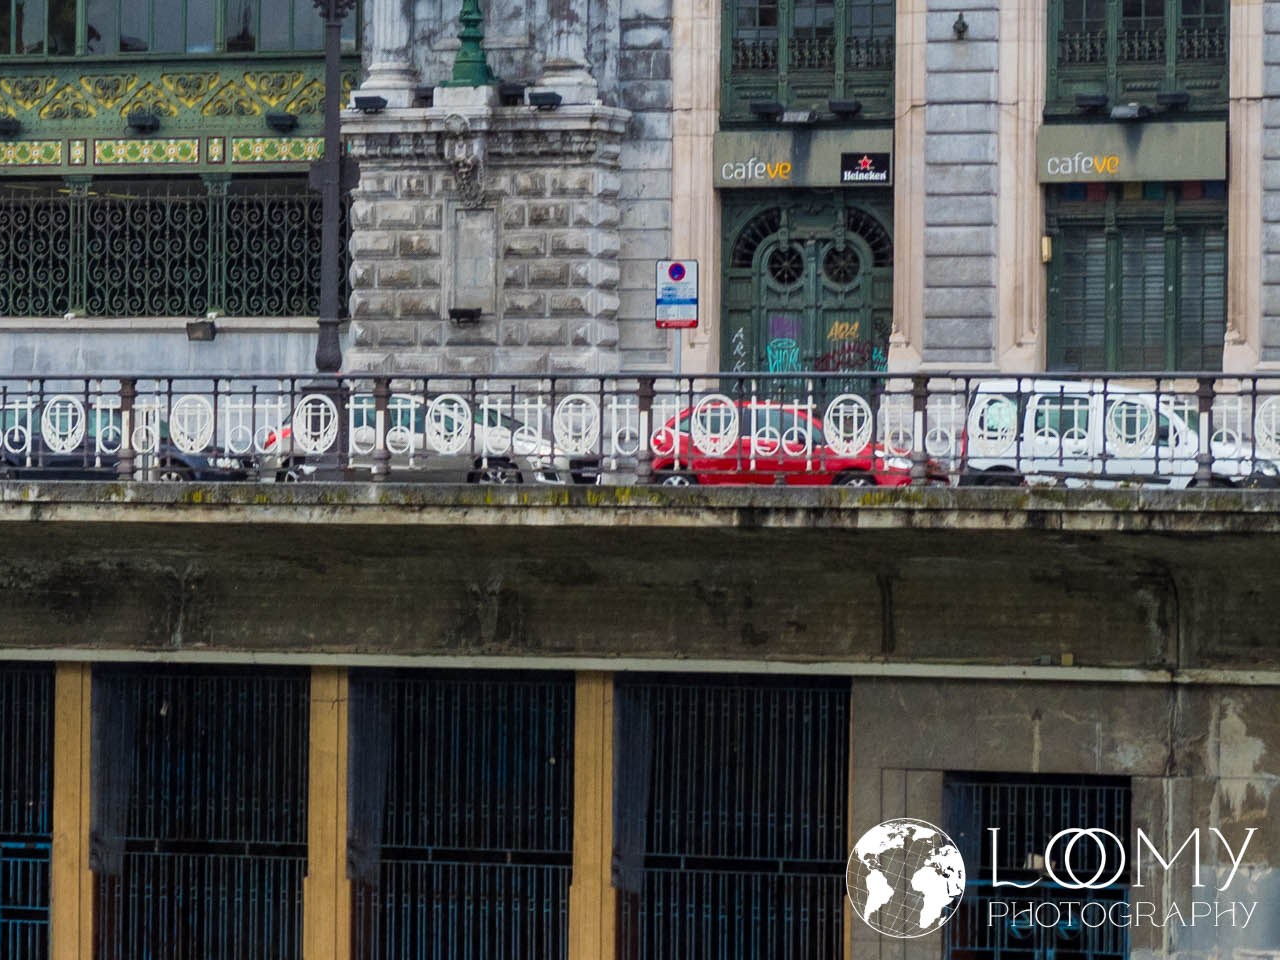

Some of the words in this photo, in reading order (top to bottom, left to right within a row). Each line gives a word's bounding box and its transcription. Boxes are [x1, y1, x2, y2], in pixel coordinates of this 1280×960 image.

[722, 157, 792, 180] cafeve
[1047, 152, 1119, 174] cafeve
[843, 170, 887, 181] Heineken
